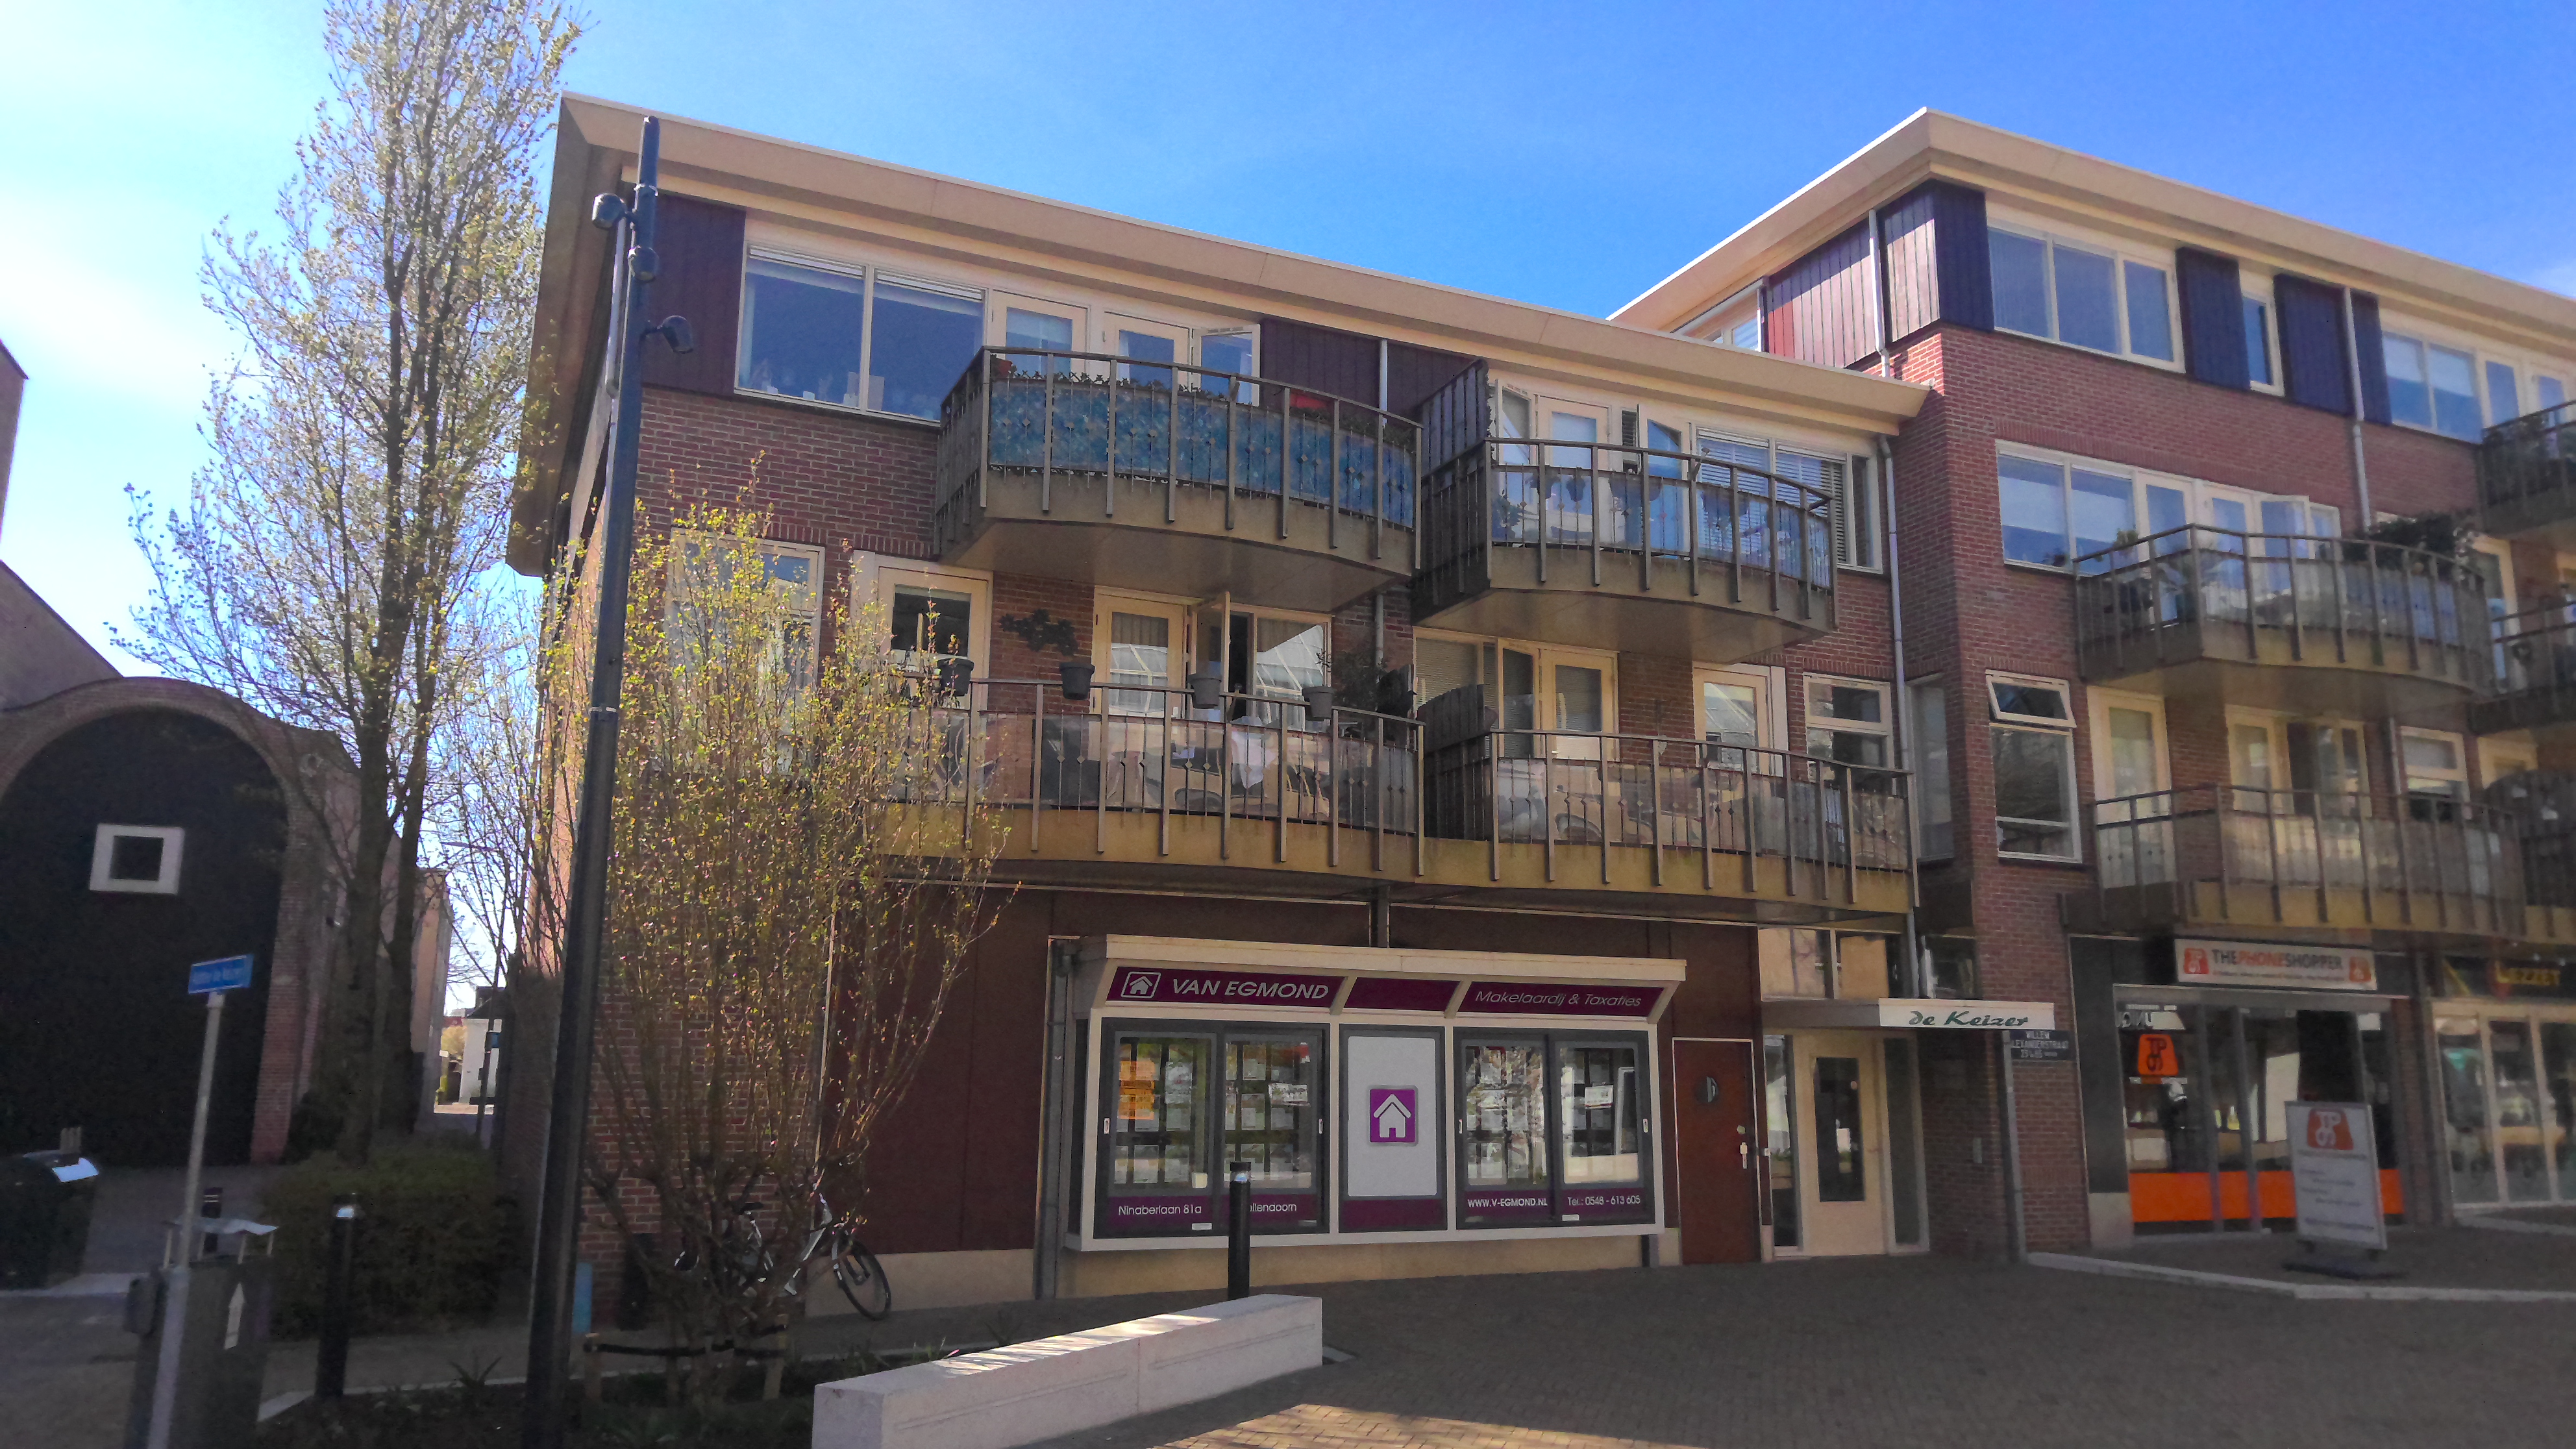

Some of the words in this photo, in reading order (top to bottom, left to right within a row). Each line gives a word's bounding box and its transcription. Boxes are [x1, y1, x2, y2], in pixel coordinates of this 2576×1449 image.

[1173, 978, 1220, 995] VAN
[1224, 981, 1329, 998] EGMOND
[1475, 991, 1567, 1006] Makelaardij
[1568, 993, 1579, 1004] &
[1584, 993, 1642, 1006] Taxaties
[1909, 1010, 1935, 1026] de
[1944, 1010, 2028, 1026] Keizer
[1467, 1198, 1548, 1208] WWW.V-EGMOND.NL
[1585, 1196, 1604, 1206] 0548
[1611, 1196, 1625, 1205] 613
[1626, 1195, 1641, 1205] 605
[1118, 1205, 1181, 1215] Ninaberlaan
[1183, 1204, 1202, 1214] 81a
[1250, 1202, 1297, 1212] llendoorn
